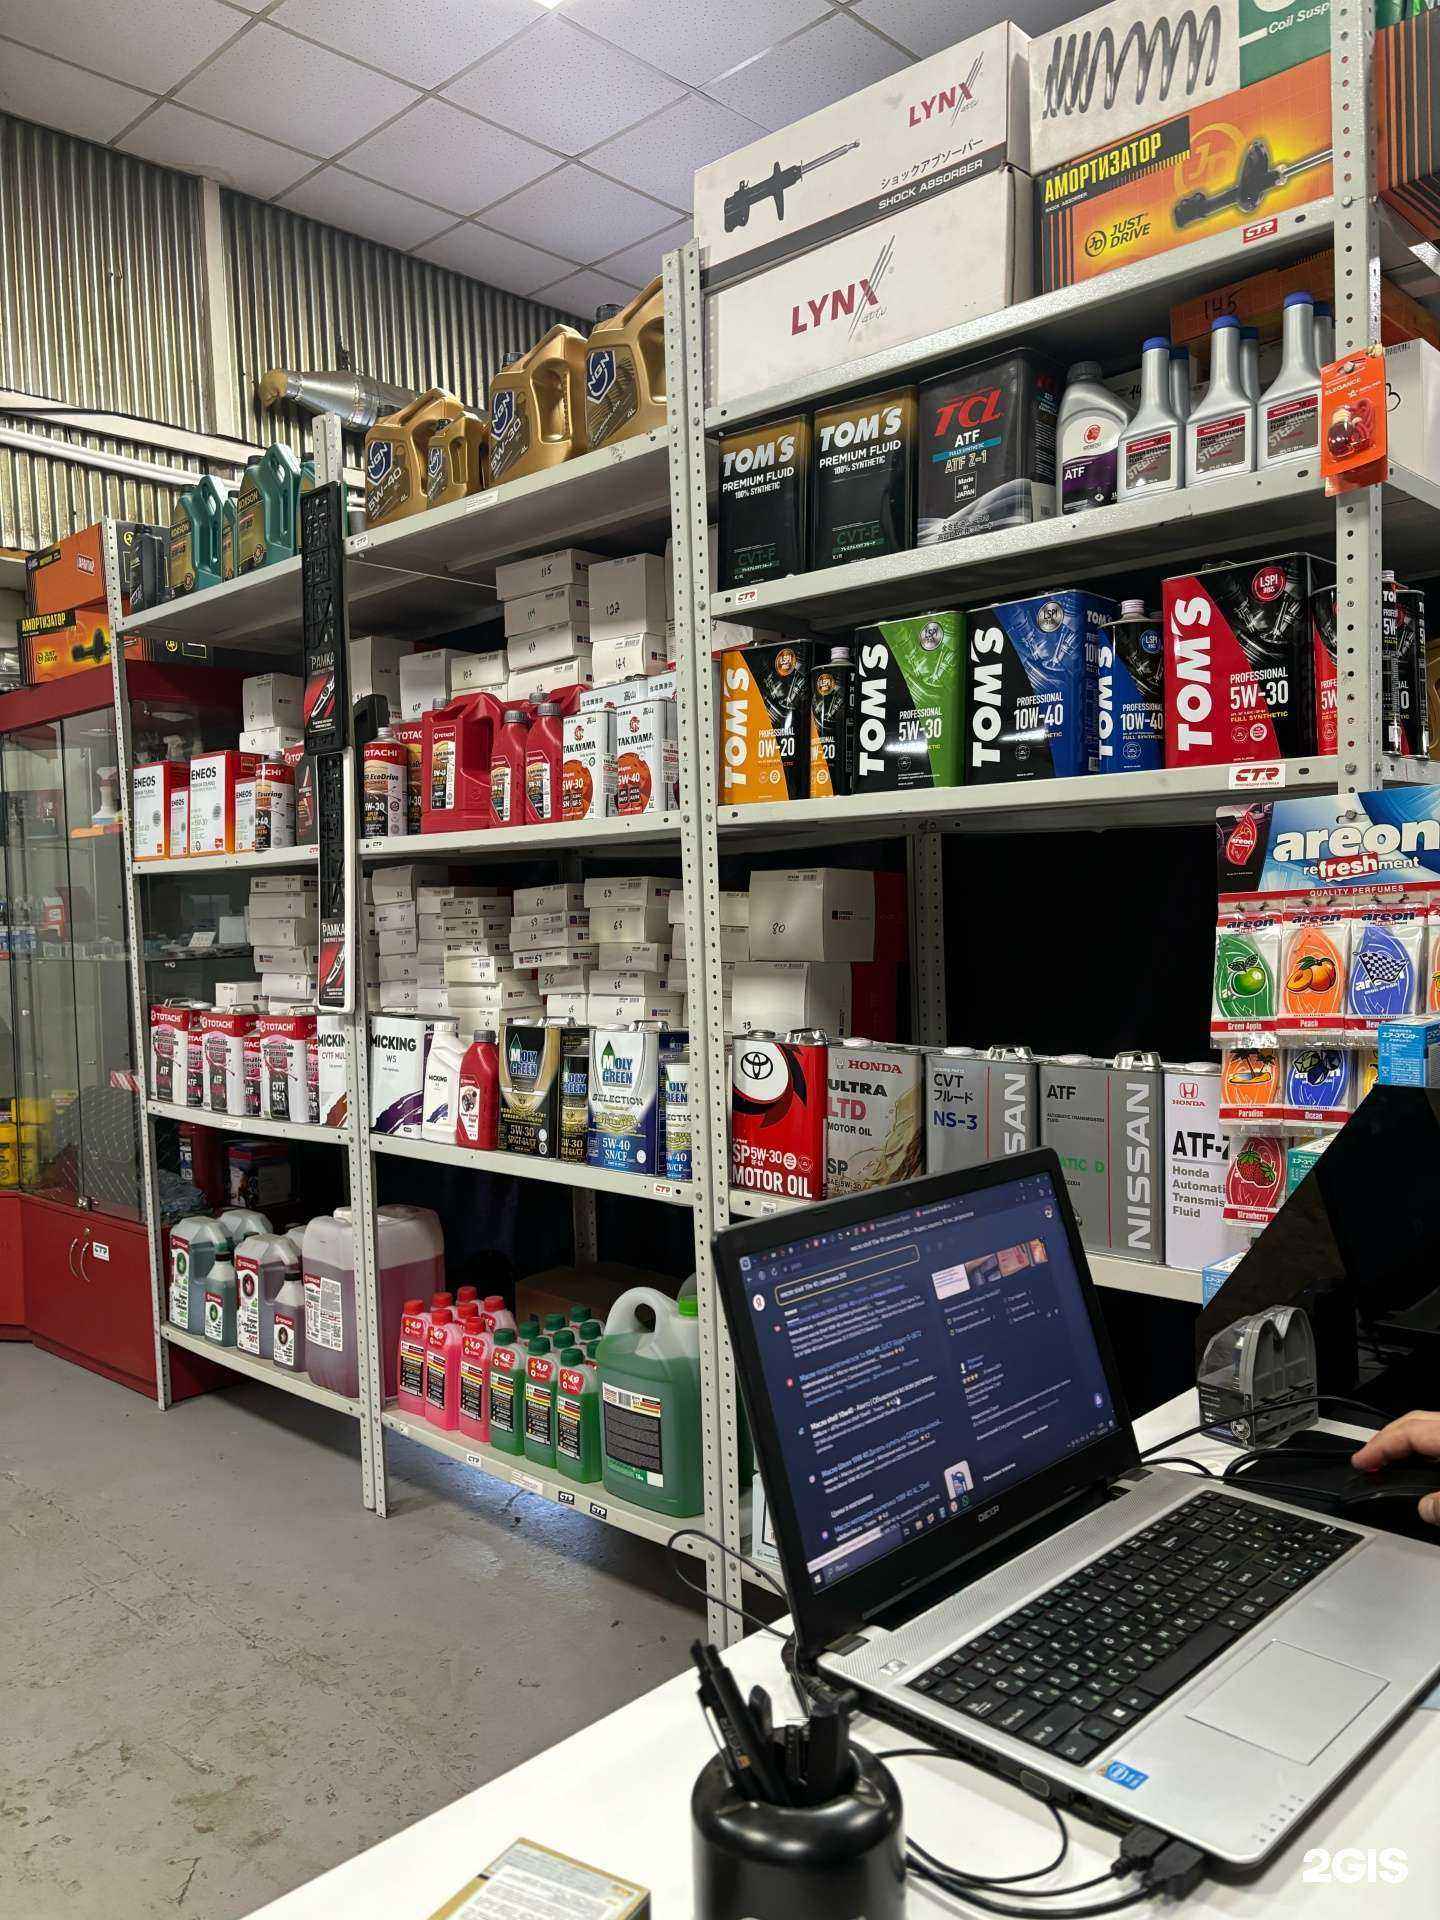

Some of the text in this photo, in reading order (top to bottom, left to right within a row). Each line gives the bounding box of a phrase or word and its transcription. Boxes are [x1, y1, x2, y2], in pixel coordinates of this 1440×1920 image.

[1268, 1, 1332, 34] Coil Susp
[909, 81, 974, 128] LYNX
[1044, 131, 1162, 204] АМОРТИЗАТОР
[878, 158, 984, 210] SHOCK ABSORBER
[1111, 213, 1145, 237] JUST
[1110, 223, 1152, 249] DRIVE
[791, 278, 880, 336] LYNX
[934, 387, 1005, 437] TCL
[819, 406, 902, 452] TOM'S
[955, 428, 981, 448] ATF
[722, 434, 795, 477] TOM'S
[819, 439, 902, 469] PREMIUM FLUID
[833, 455, 886, 476] 100% SYNTHETIC
[945, 455, 966, 474] ATF
[722, 466, 795, 493] PREMIUM FLUID
[1064, 466, 1086, 481] ATF
[750, 481, 781, 496] SYNTHETIC
[1260, 573, 1278, 588] LSPI
[21, 612, 66, 632] АМОРТИЗАТОР
[1171, 596, 1212, 752] TOM'S
[1230, 666, 1289, 684] PROFESSIONAL
[970, 627, 1005, 768] TOM'S
[1016, 691, 1064, 707] PROFESSIONAL
[1230, 679, 1289, 710] 5W-30
[1321, 689, 1338, 710] 5W
[858, 643, 890, 777] TOM'S
[899, 706, 943, 720] PROFESSIONAL
[1013, 703, 1064, 731] 10W-40
[1231, 714, 1248, 723] FULL
[1249, 710, 1289, 721] SYNTHETIC
[724, 667, 750, 789] TOM'S
[1120, 712, 1164, 731] 10W-40
[898, 718, 943, 743] 5W-30
[563, 741, 596, 754] TAKAYAMA
[618, 732, 655, 747] TAKAYAMA
[758, 737, 795, 758] 0W-20
[365, 749, 398, 757] OTACHI
[811, 744, 836, 760] W-20
[191, 766, 217, 780] ENEOS
[370, 773, 399, 781] EcoDrive
[618, 772, 641, 785] 5W-40
[1235, 767, 1280, 782] CTR
[134, 775, 156, 789] ENEOS
[562, 778, 584, 790] 5W-30
[1273, 817, 1440, 862] areon
[1303, 851, 1420, 879] refreshment
[1309, 884, 1405, 898] QUALITY PERFUMES
[1227, 918, 1274, 929] areon
[1292, 912, 1341, 924] areon
[1362, 910, 1415, 922] areon
[156, 1012, 181, 1022] TOTACHI
[208, 1019, 234, 1029] TOTACHI
[1300, 1019, 1319, 1028] Peach
[266, 1022, 294, 1031] TOTACHI
[318, 1033, 346, 1047] MICKIN
[370, 1034, 417, 1052] MICKING
[510, 1048, 538, 1064] MOLY
[602, 1054, 633, 1071] MOLY
[510, 1062, 538, 1077] GREEN
[848, 1059, 903, 1075] HONDA
[602, 1070, 633, 1084] GREEN
[933, 1073, 964, 1089] CVT
[827, 1078, 888, 1098] ULTRA
[1046, 1084, 1077, 1100] ATF
[592, 1093, 644, 1106] SELECTION
[933, 1090, 975, 1105] フルード
[1171, 1098, 1207, 1107] HONDA
[827, 1097, 867, 1121] LTD
[1004, 1072, 1026, 1155] SAN
[1238, 1109, 1264, 1118] Paradise
[1304, 1111, 1323, 1120] Ocean
[933, 1110, 979, 1131] NS-3
[827, 1121, 873, 1137] MOTOR OIL
[602, 1137, 631, 1151] 5W-40
[604, 1150, 628, 1161] SN/CF
[733, 1144, 750, 1164] SP
[750, 1147, 782, 1164] 5W-30
[827, 1157, 849, 1177] SP
[1095, 1161, 1105, 1174] D
[1125, 1082, 1152, 1250] NISSAN
[1172, 1165, 1210, 1179] Honda
[732, 1165, 813, 1198] MOTOR OIL
[1172, 1179, 1227, 1194] Automati
[1172, 1192, 1226, 1208] Transmis
[1172, 1206, 1201, 1218] Fluid
